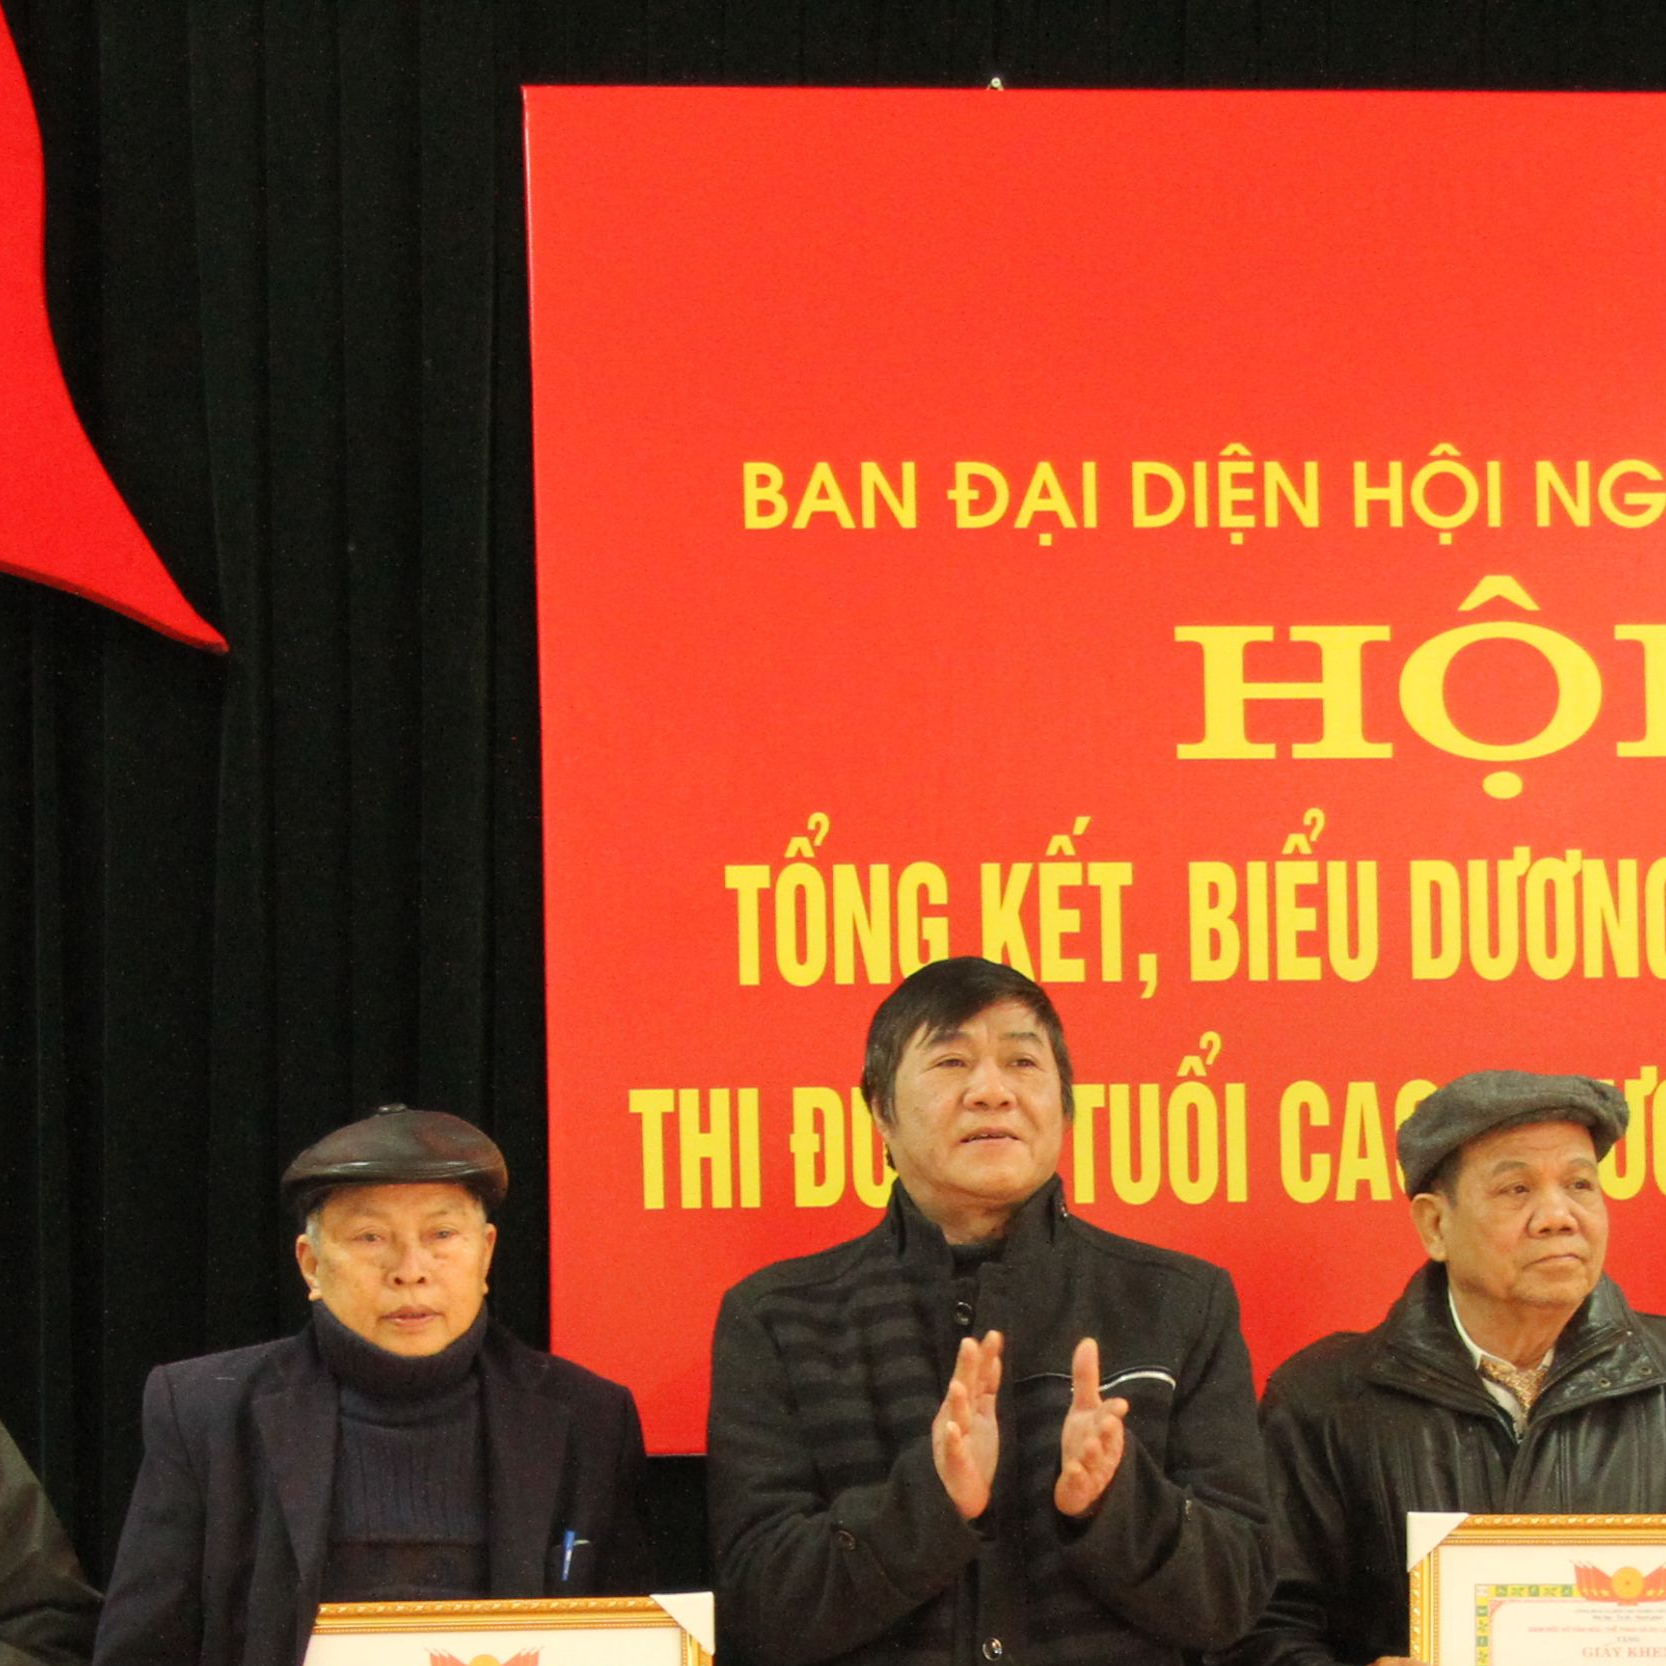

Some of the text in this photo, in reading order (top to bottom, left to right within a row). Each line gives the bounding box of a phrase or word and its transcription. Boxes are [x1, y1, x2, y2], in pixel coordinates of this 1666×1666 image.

[743, 460, 917, 530] BAN
[945, 460, 1098, 548] ĐẠI
[1131, 442, 1320, 547] DIỆN
[1353, 442, 1503, 547] HỘI
[724, 811, 950, 988] TỔNG
[980, 815, 1159, 1000] KẾT,
[1188, 806, 1380, 984] BIỂU
[628, 1087, 762, 1210] THI
[789, 1086, 895, 1209] ĐU
[1073, 1030, 1249, 1206] TUỔI
